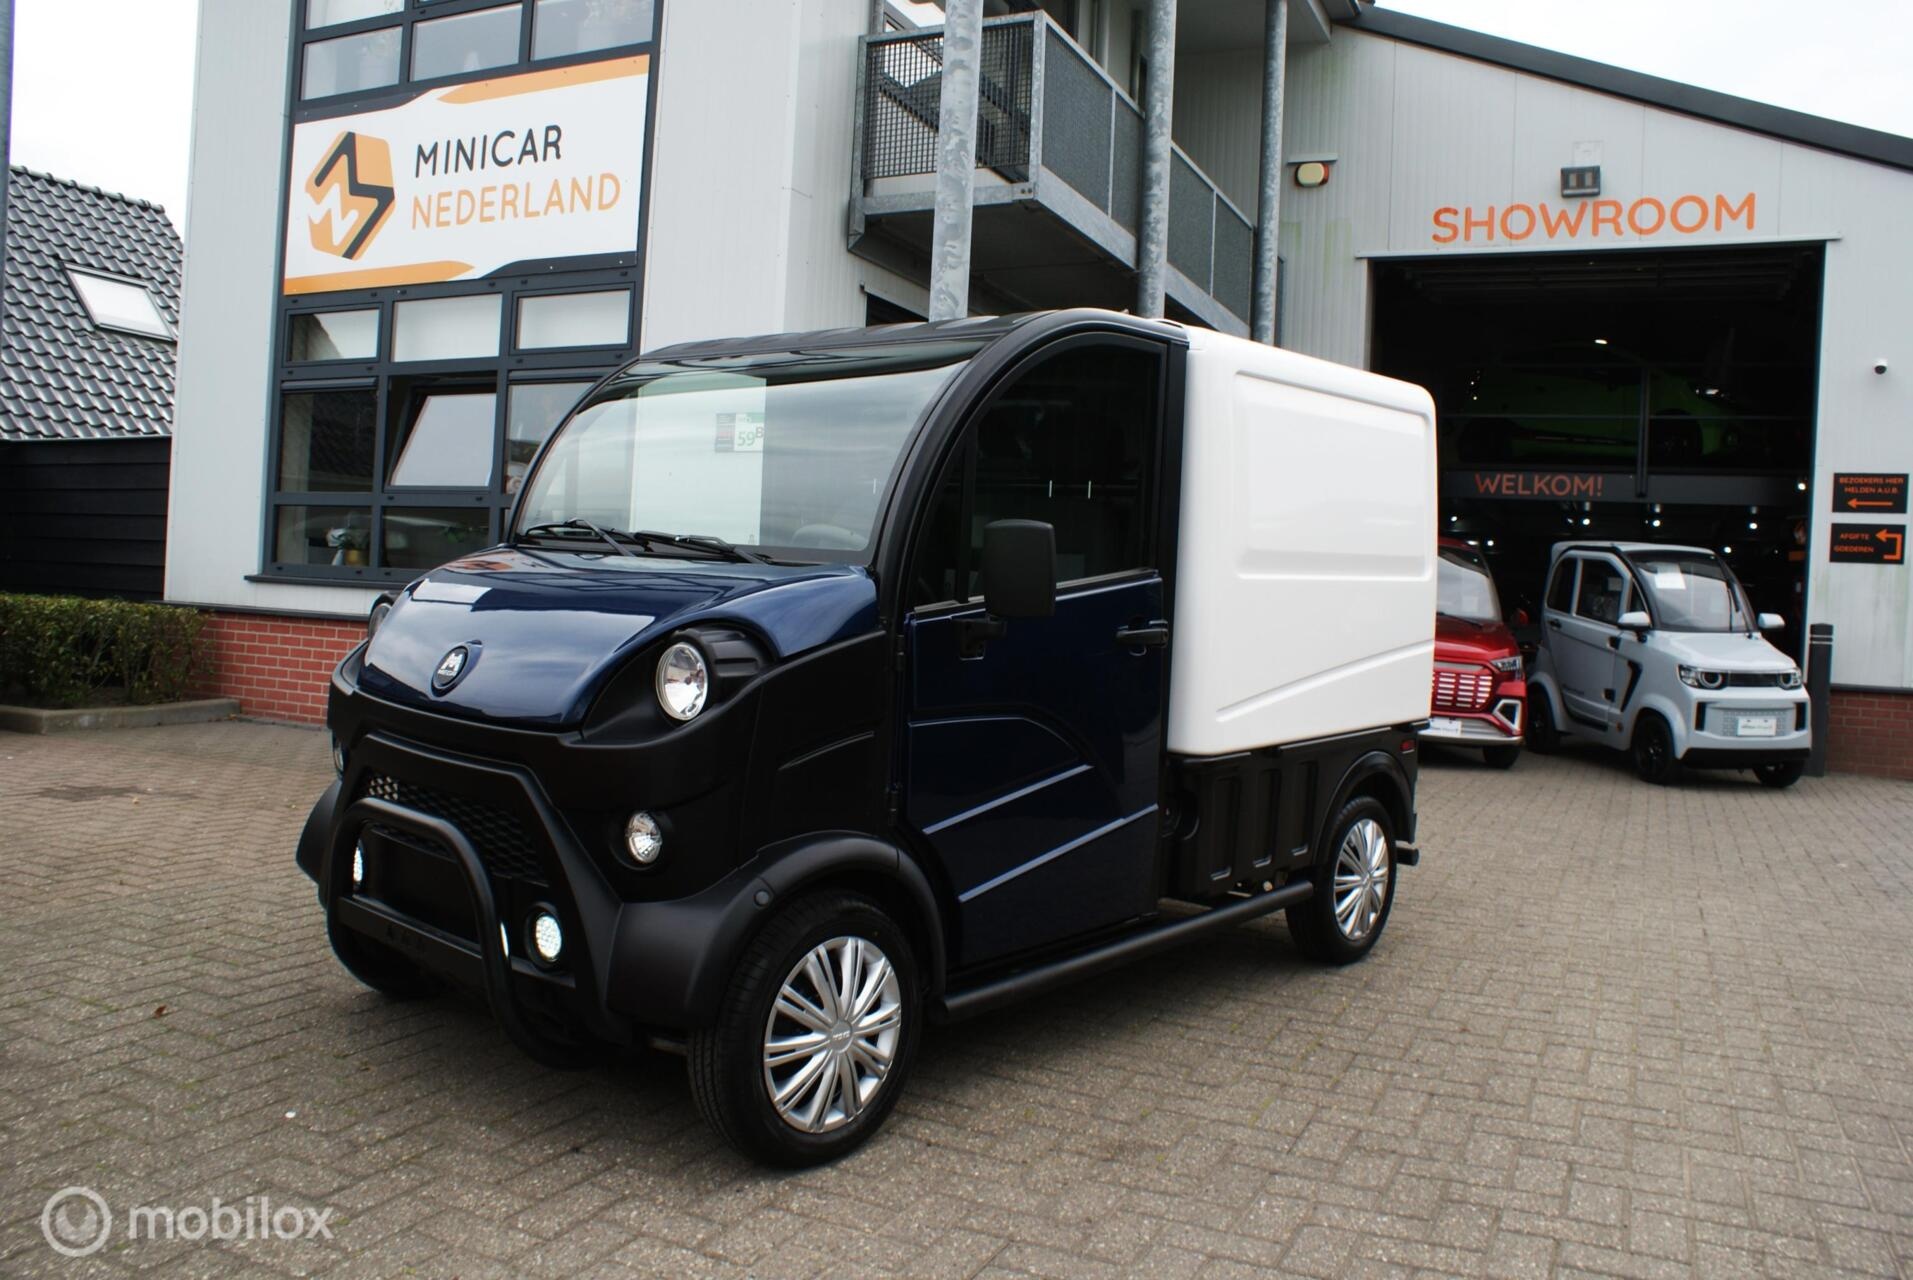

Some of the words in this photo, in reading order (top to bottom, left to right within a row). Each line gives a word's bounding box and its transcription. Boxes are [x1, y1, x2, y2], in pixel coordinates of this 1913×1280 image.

[415, 124, 562, 178] MINICAR
[412, 173, 621, 230] NEDERLAND
[1431, 192, 1756, 243] SHOWROOM
[1473, 473, 1603, 497] WELKOM!
[1839, 477, 1884, 485] BEZOEKERS
[1844, 486, 1876, 494] MELDEN
[1840, 532, 1871, 541] AFGIFTE
[1833, 545, 1875, 553] GOEDEREN
